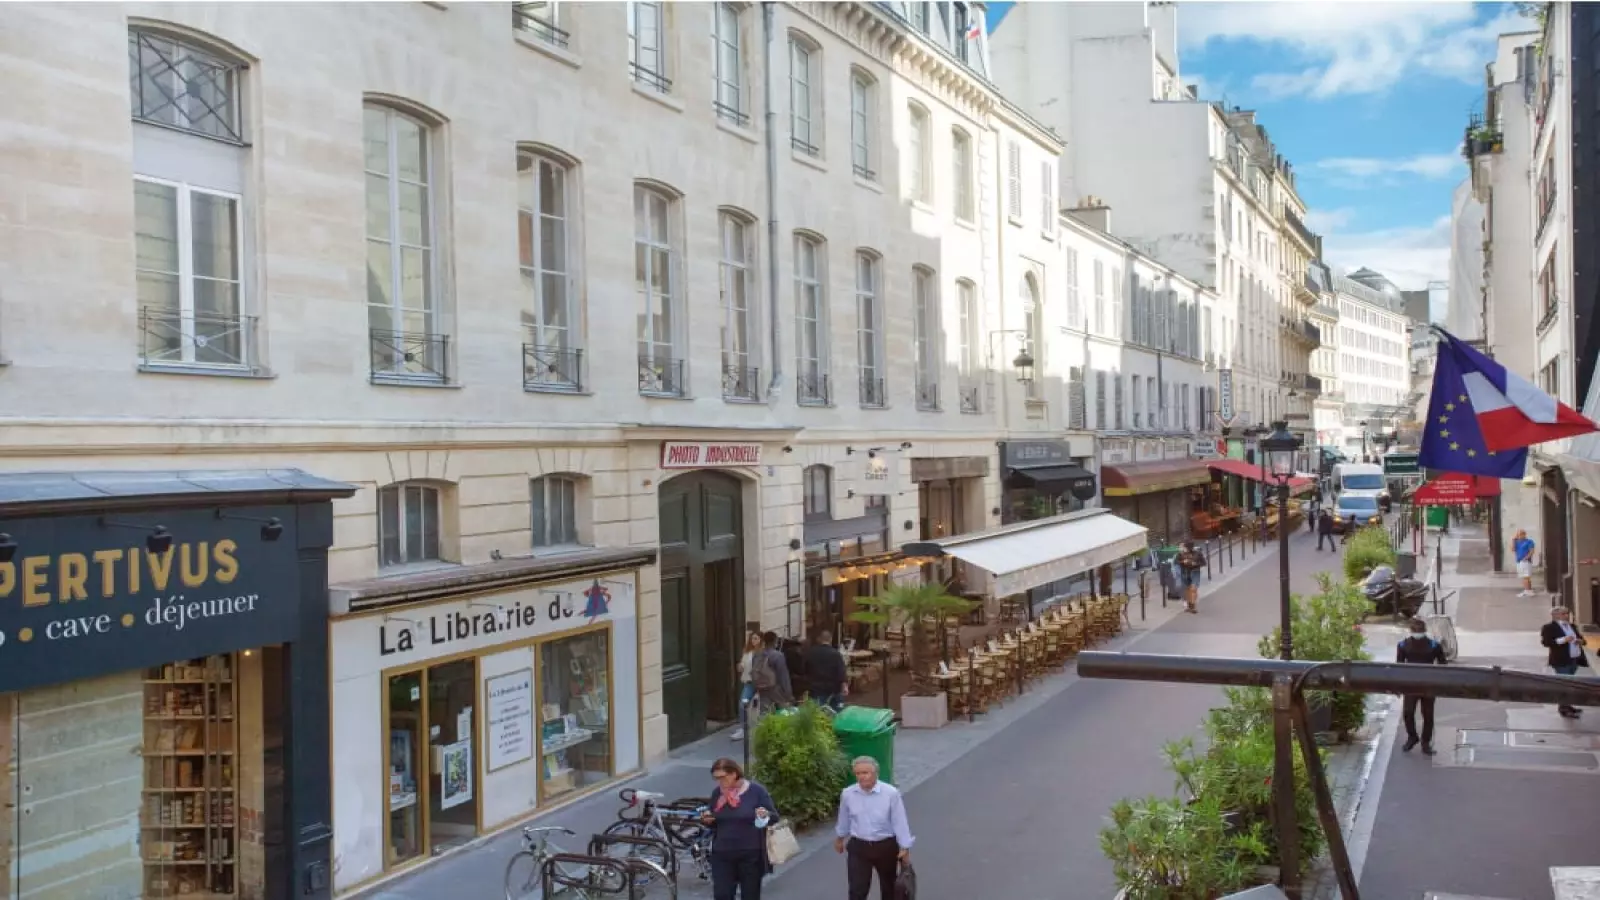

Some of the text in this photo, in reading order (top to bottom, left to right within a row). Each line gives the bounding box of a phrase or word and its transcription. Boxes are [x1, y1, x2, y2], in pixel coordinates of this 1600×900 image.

[669, 445, 700, 463] PHOTO
[46, 593, 258, 640] cave déjeuner
[379, 626, 414, 656] La
